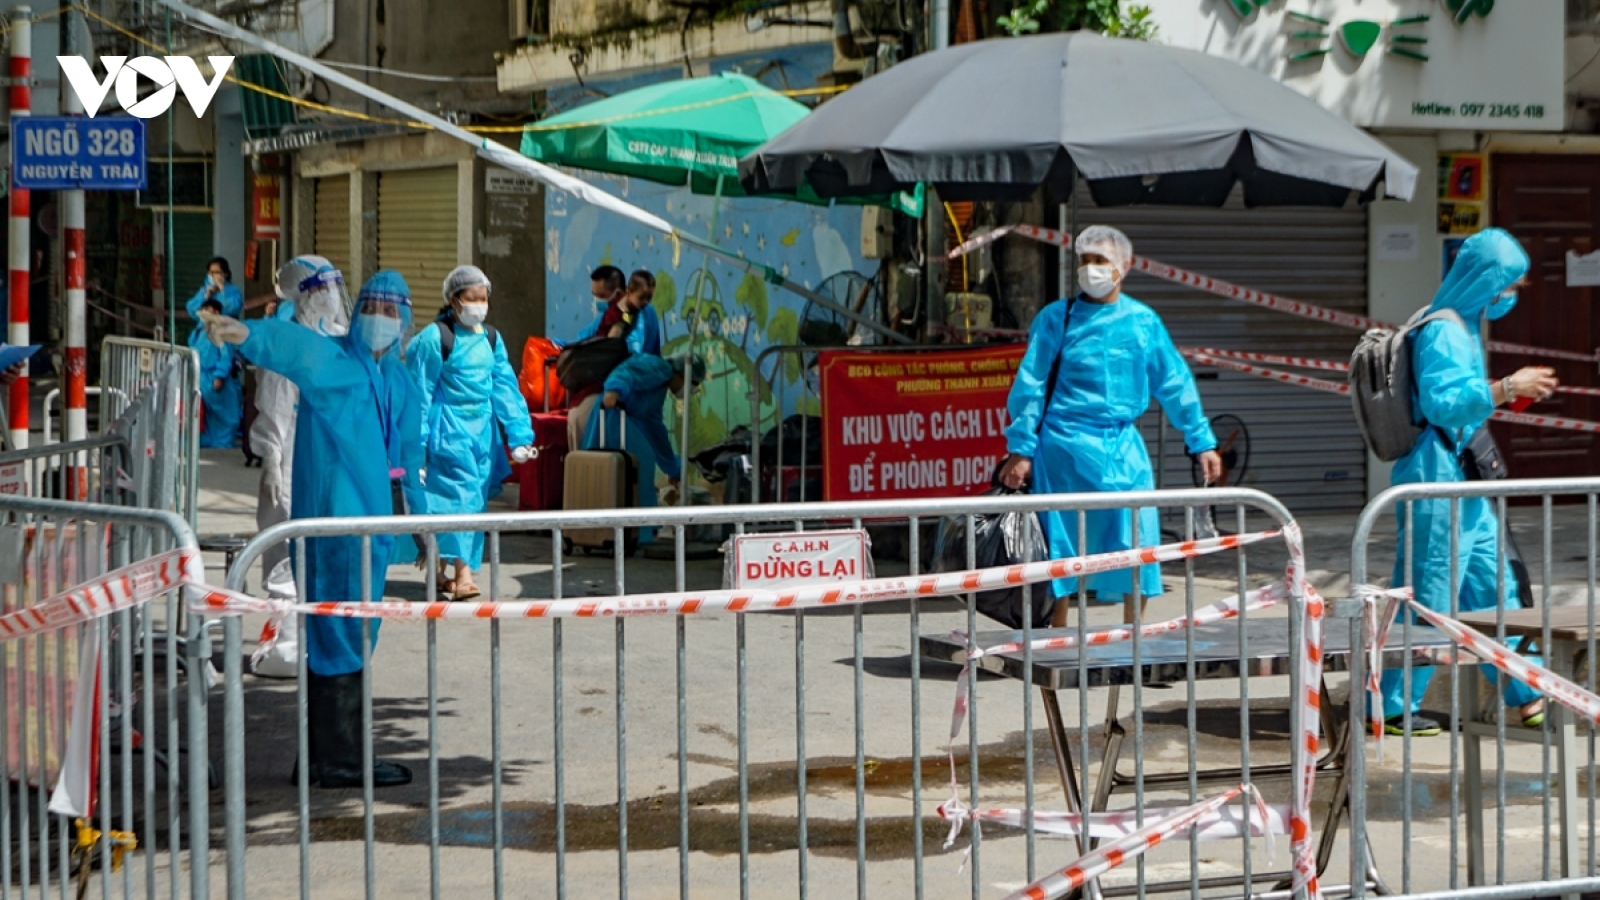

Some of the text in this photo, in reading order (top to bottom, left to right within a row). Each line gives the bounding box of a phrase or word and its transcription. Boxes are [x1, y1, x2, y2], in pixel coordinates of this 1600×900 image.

[1459, 102, 1485, 117] 097
[1488, 103, 1520, 118] 2345
[25, 122, 135, 157] NGÕ 328
[22, 161, 93, 179] NGUYỄN
[944, 377, 979, 390] THANH
[982, 374, 1010, 387] XUÂN
[842, 405, 1007, 449] KHU VỰC CÁCH LY
[849, 451, 996, 492] ĐỂ PHÒNG DỊCH
[772, 540, 829, 553] C.A.H.N
[746, 555, 855, 580] DỪNG LẠI
